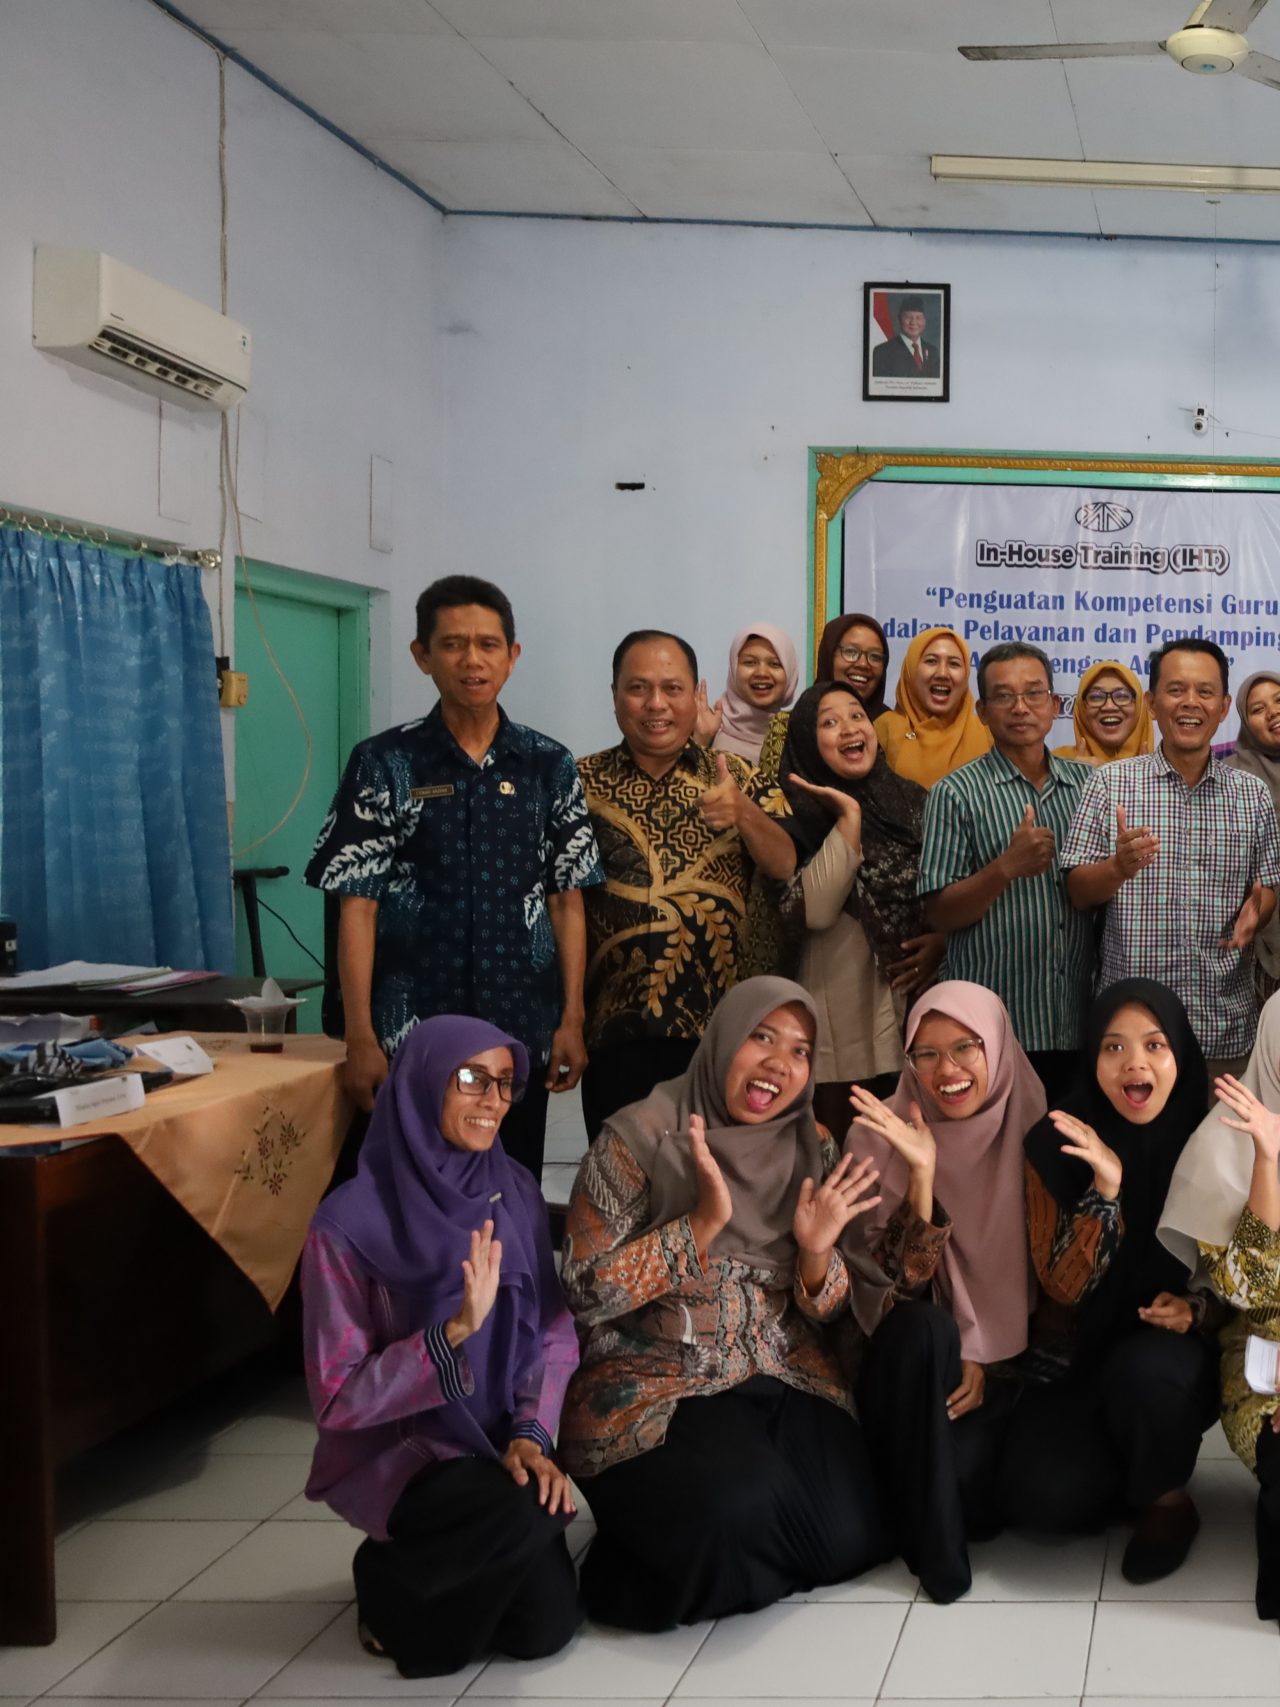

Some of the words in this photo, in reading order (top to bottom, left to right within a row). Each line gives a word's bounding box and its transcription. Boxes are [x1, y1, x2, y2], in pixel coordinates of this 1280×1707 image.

[977, 541, 1076, 566] In-House
[1078, 543, 1169, 572] Training
[1170, 545, 1229, 574] (IHT)
[926, 587, 1065, 614] “Penguatan
[1074, 590, 1213, 616] Kompetensi
[1221, 594, 1279, 616] Guru
[963, 619, 1085, 642] Pelayanan
[1094, 622, 1137, 643] dan
